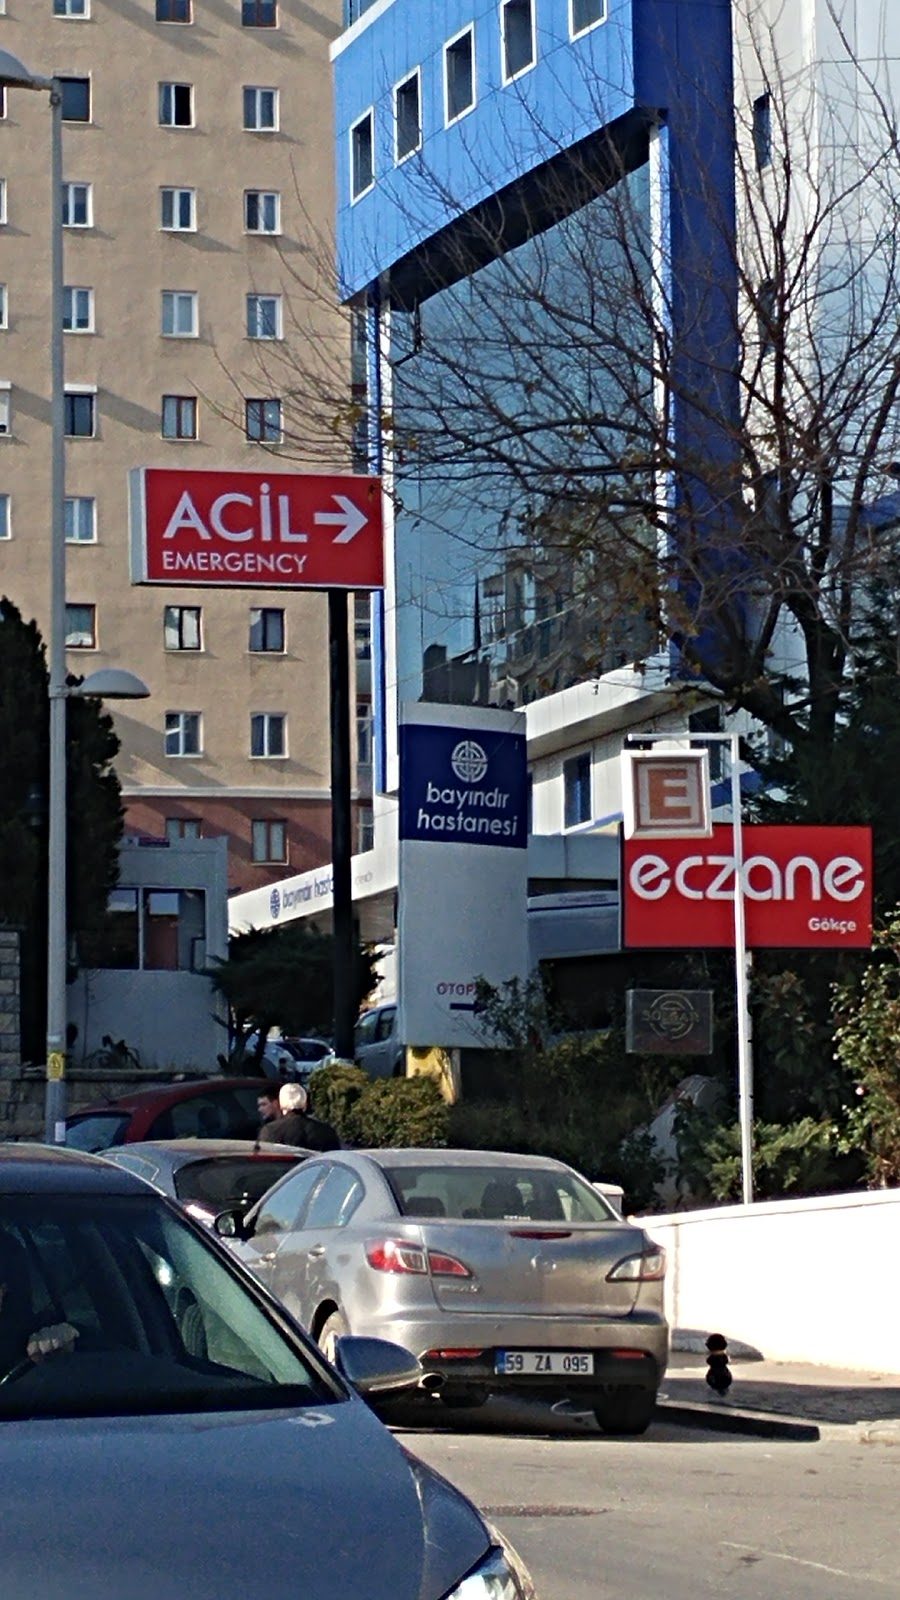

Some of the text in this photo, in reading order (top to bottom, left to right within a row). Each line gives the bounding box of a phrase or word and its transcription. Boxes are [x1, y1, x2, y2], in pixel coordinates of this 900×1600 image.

[162, 482, 308, 543] ACİL
[162, 551, 308, 574] EMERGENCY
[426, 782, 510, 810] bayındır
[647, 769, 693, 820] E
[417, 808, 518, 836] hastanesi
[629, 854, 865, 902] eczane
[808, 917, 857, 934] Gökçe
[506, 1354, 589, 1373] 59 ZA 095
